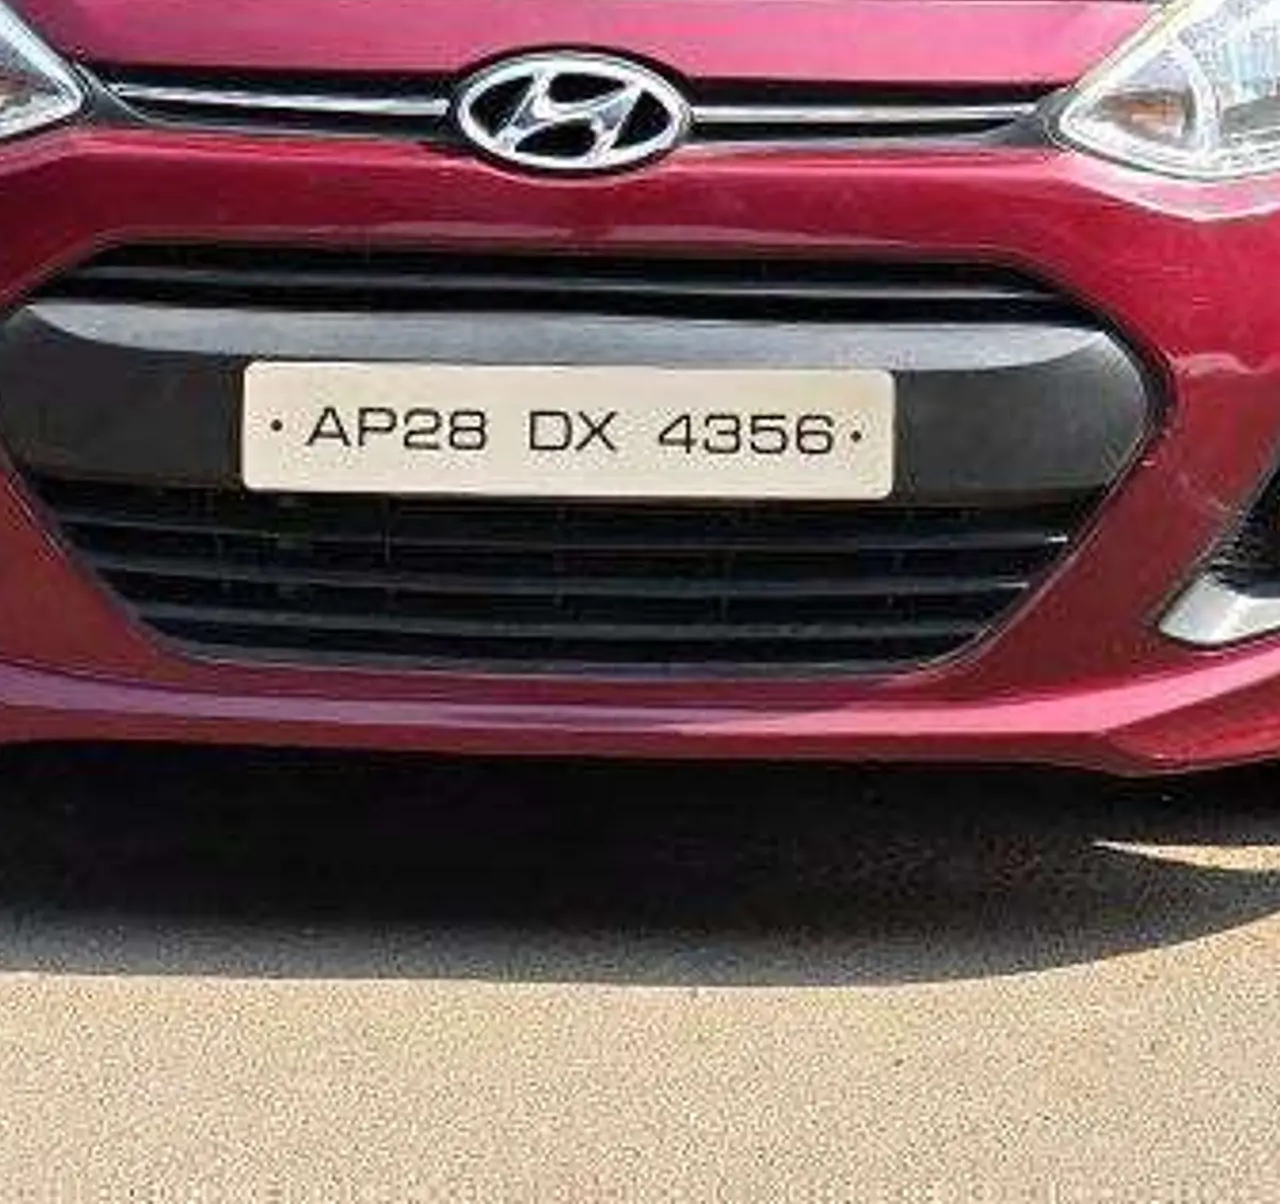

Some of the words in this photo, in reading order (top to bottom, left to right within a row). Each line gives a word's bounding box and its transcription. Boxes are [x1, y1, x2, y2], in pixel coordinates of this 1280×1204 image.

[306, 406, 488, 452] AP28
[528, 409, 617, 453] DX
[657, 412, 836, 456] 4356
